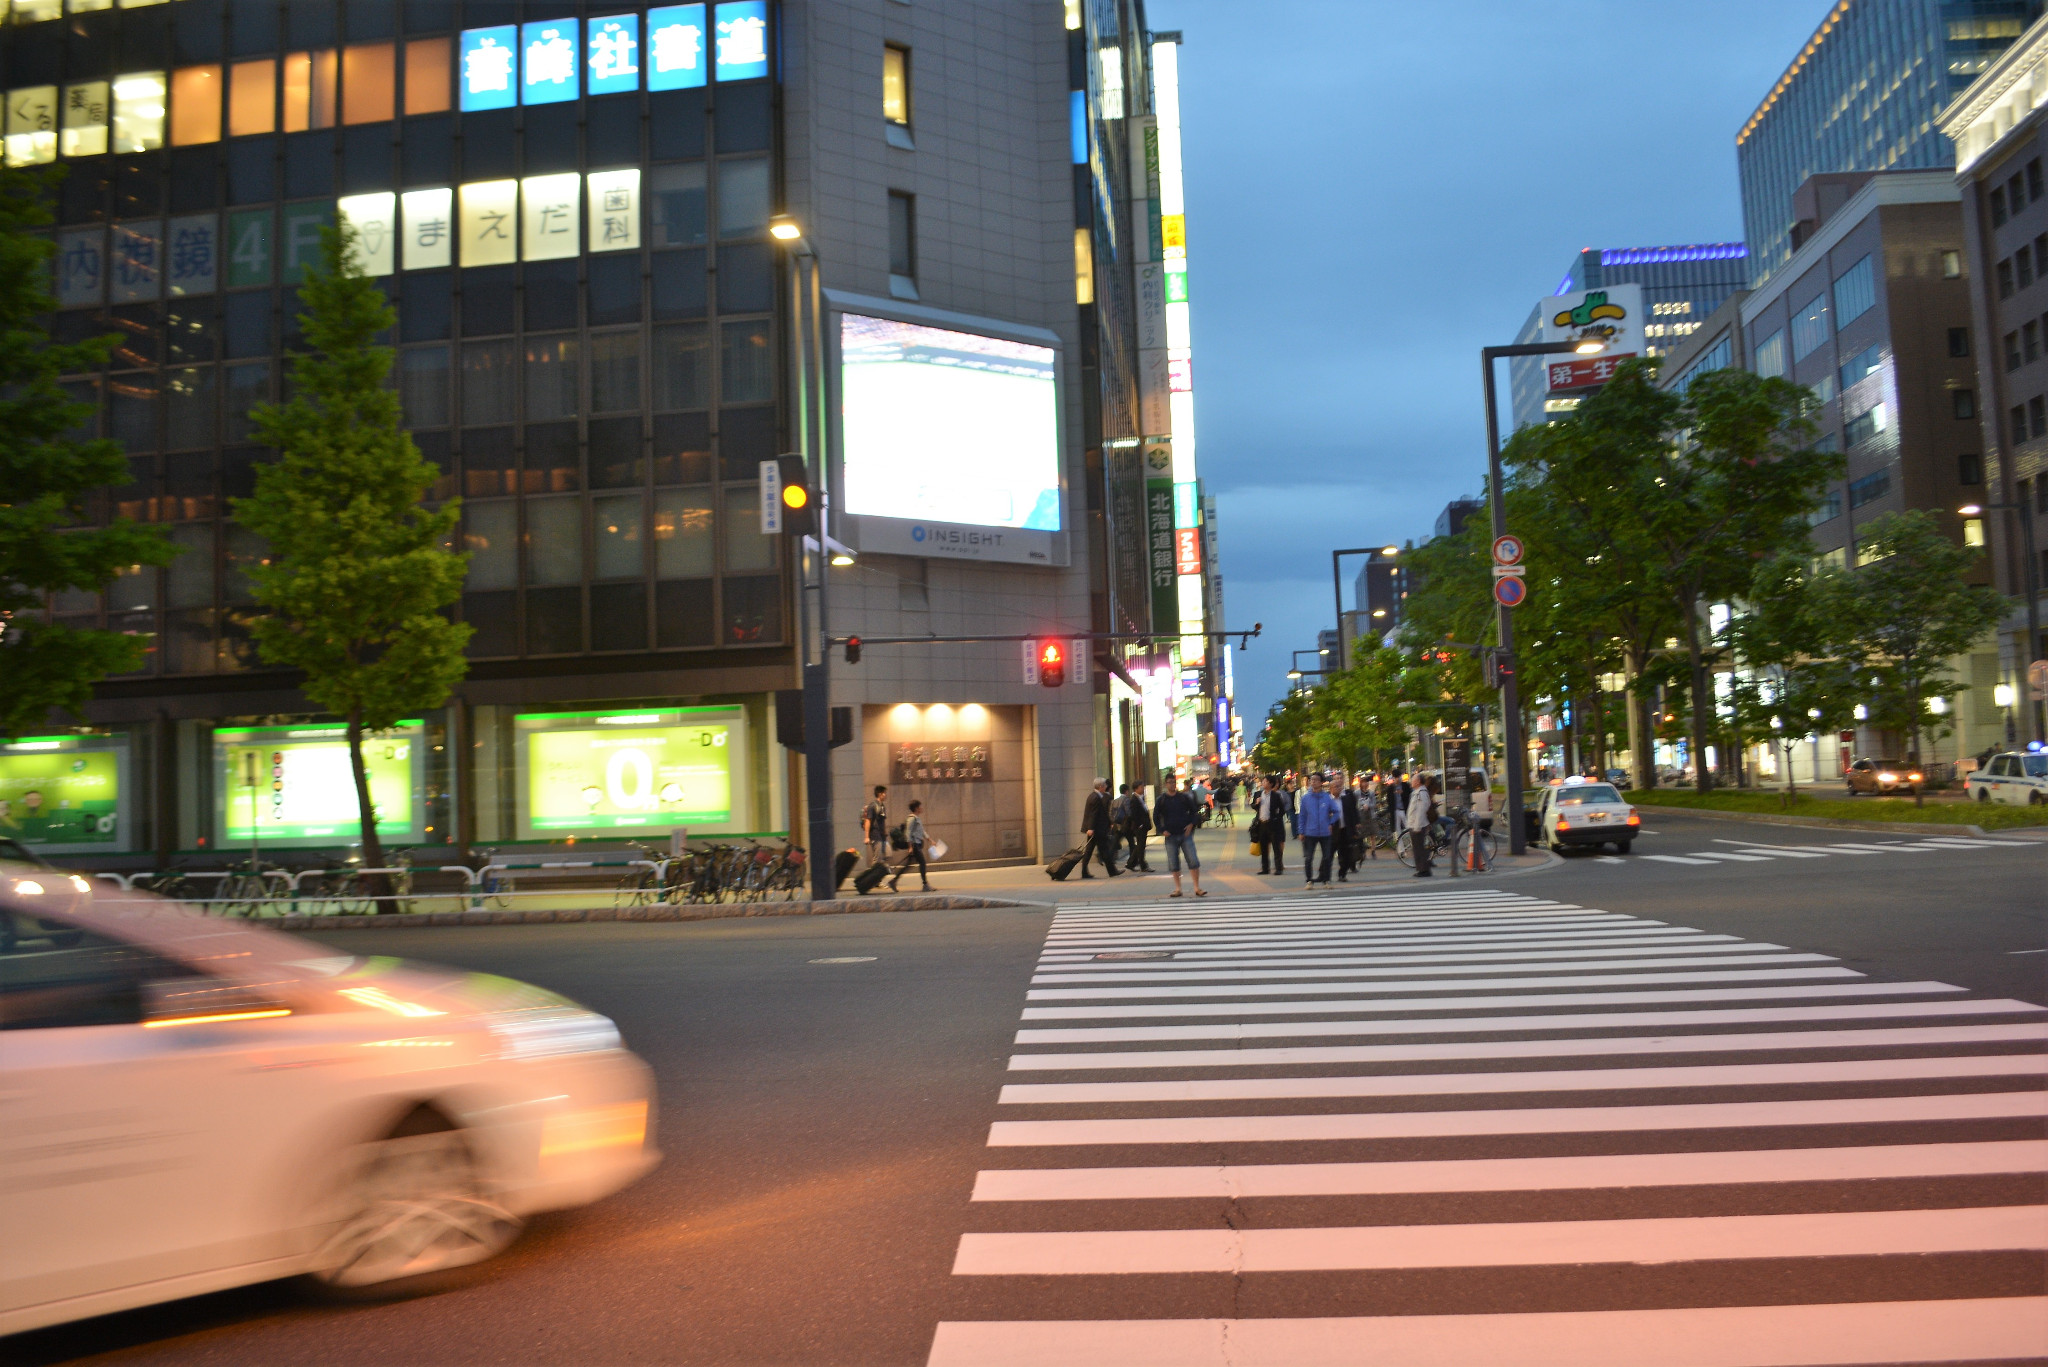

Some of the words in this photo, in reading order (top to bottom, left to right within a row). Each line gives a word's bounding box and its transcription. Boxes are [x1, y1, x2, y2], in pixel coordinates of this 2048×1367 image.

[1552, 359, 1624, 385] 第一生
[927, 529, 1005, 547] INSIGHT
[1152, 492, 1173, 587] 北海道銀行
[897, 745, 987, 764] 北海道銀行
